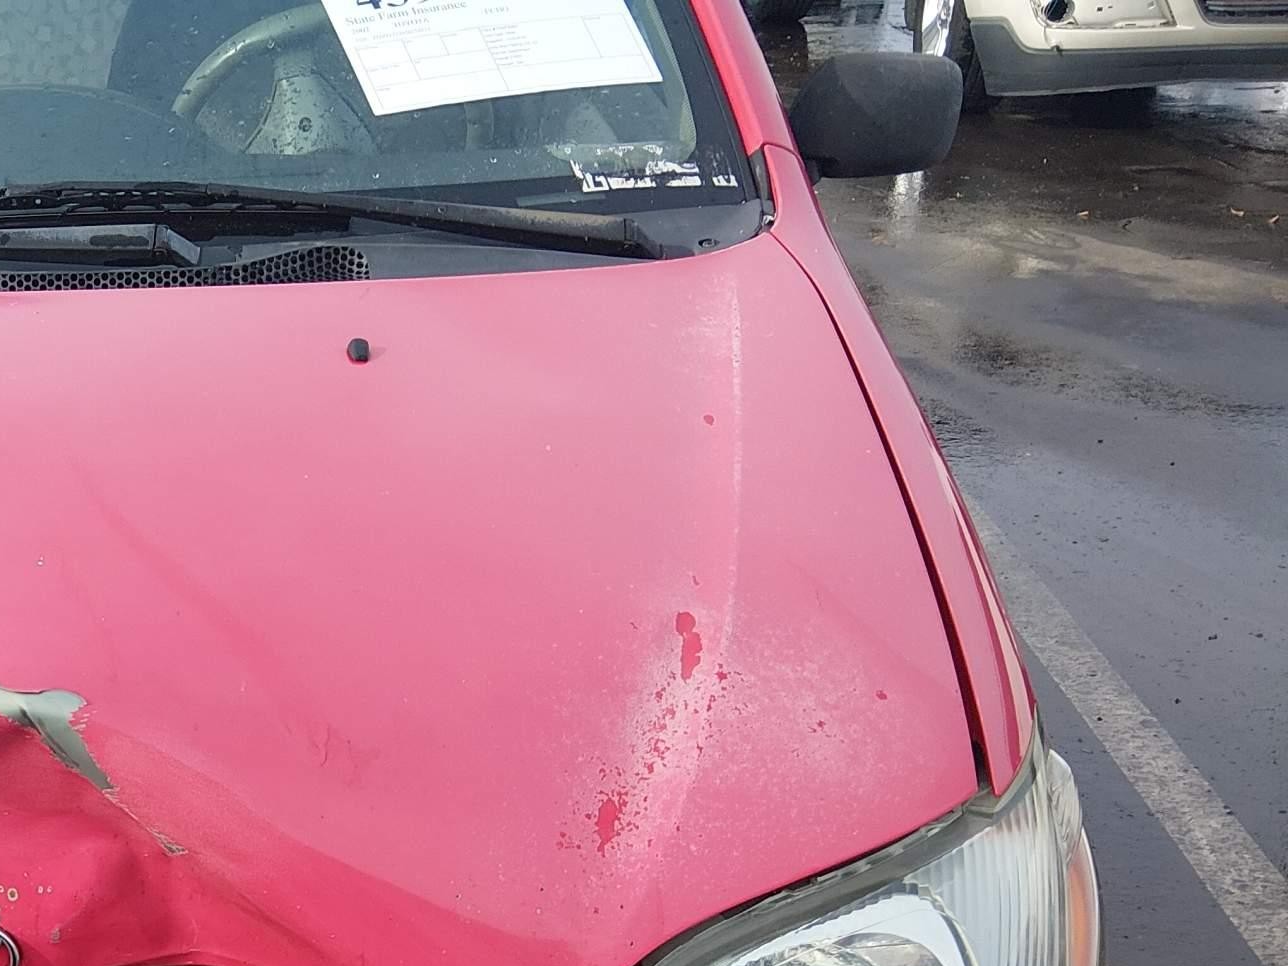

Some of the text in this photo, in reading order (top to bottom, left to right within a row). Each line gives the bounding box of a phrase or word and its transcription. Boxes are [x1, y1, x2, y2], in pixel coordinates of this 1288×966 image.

[345, 15, 376, 27] State
[377, 9, 410, 21] Farm
[411, 1, 468, 16] Insurance
